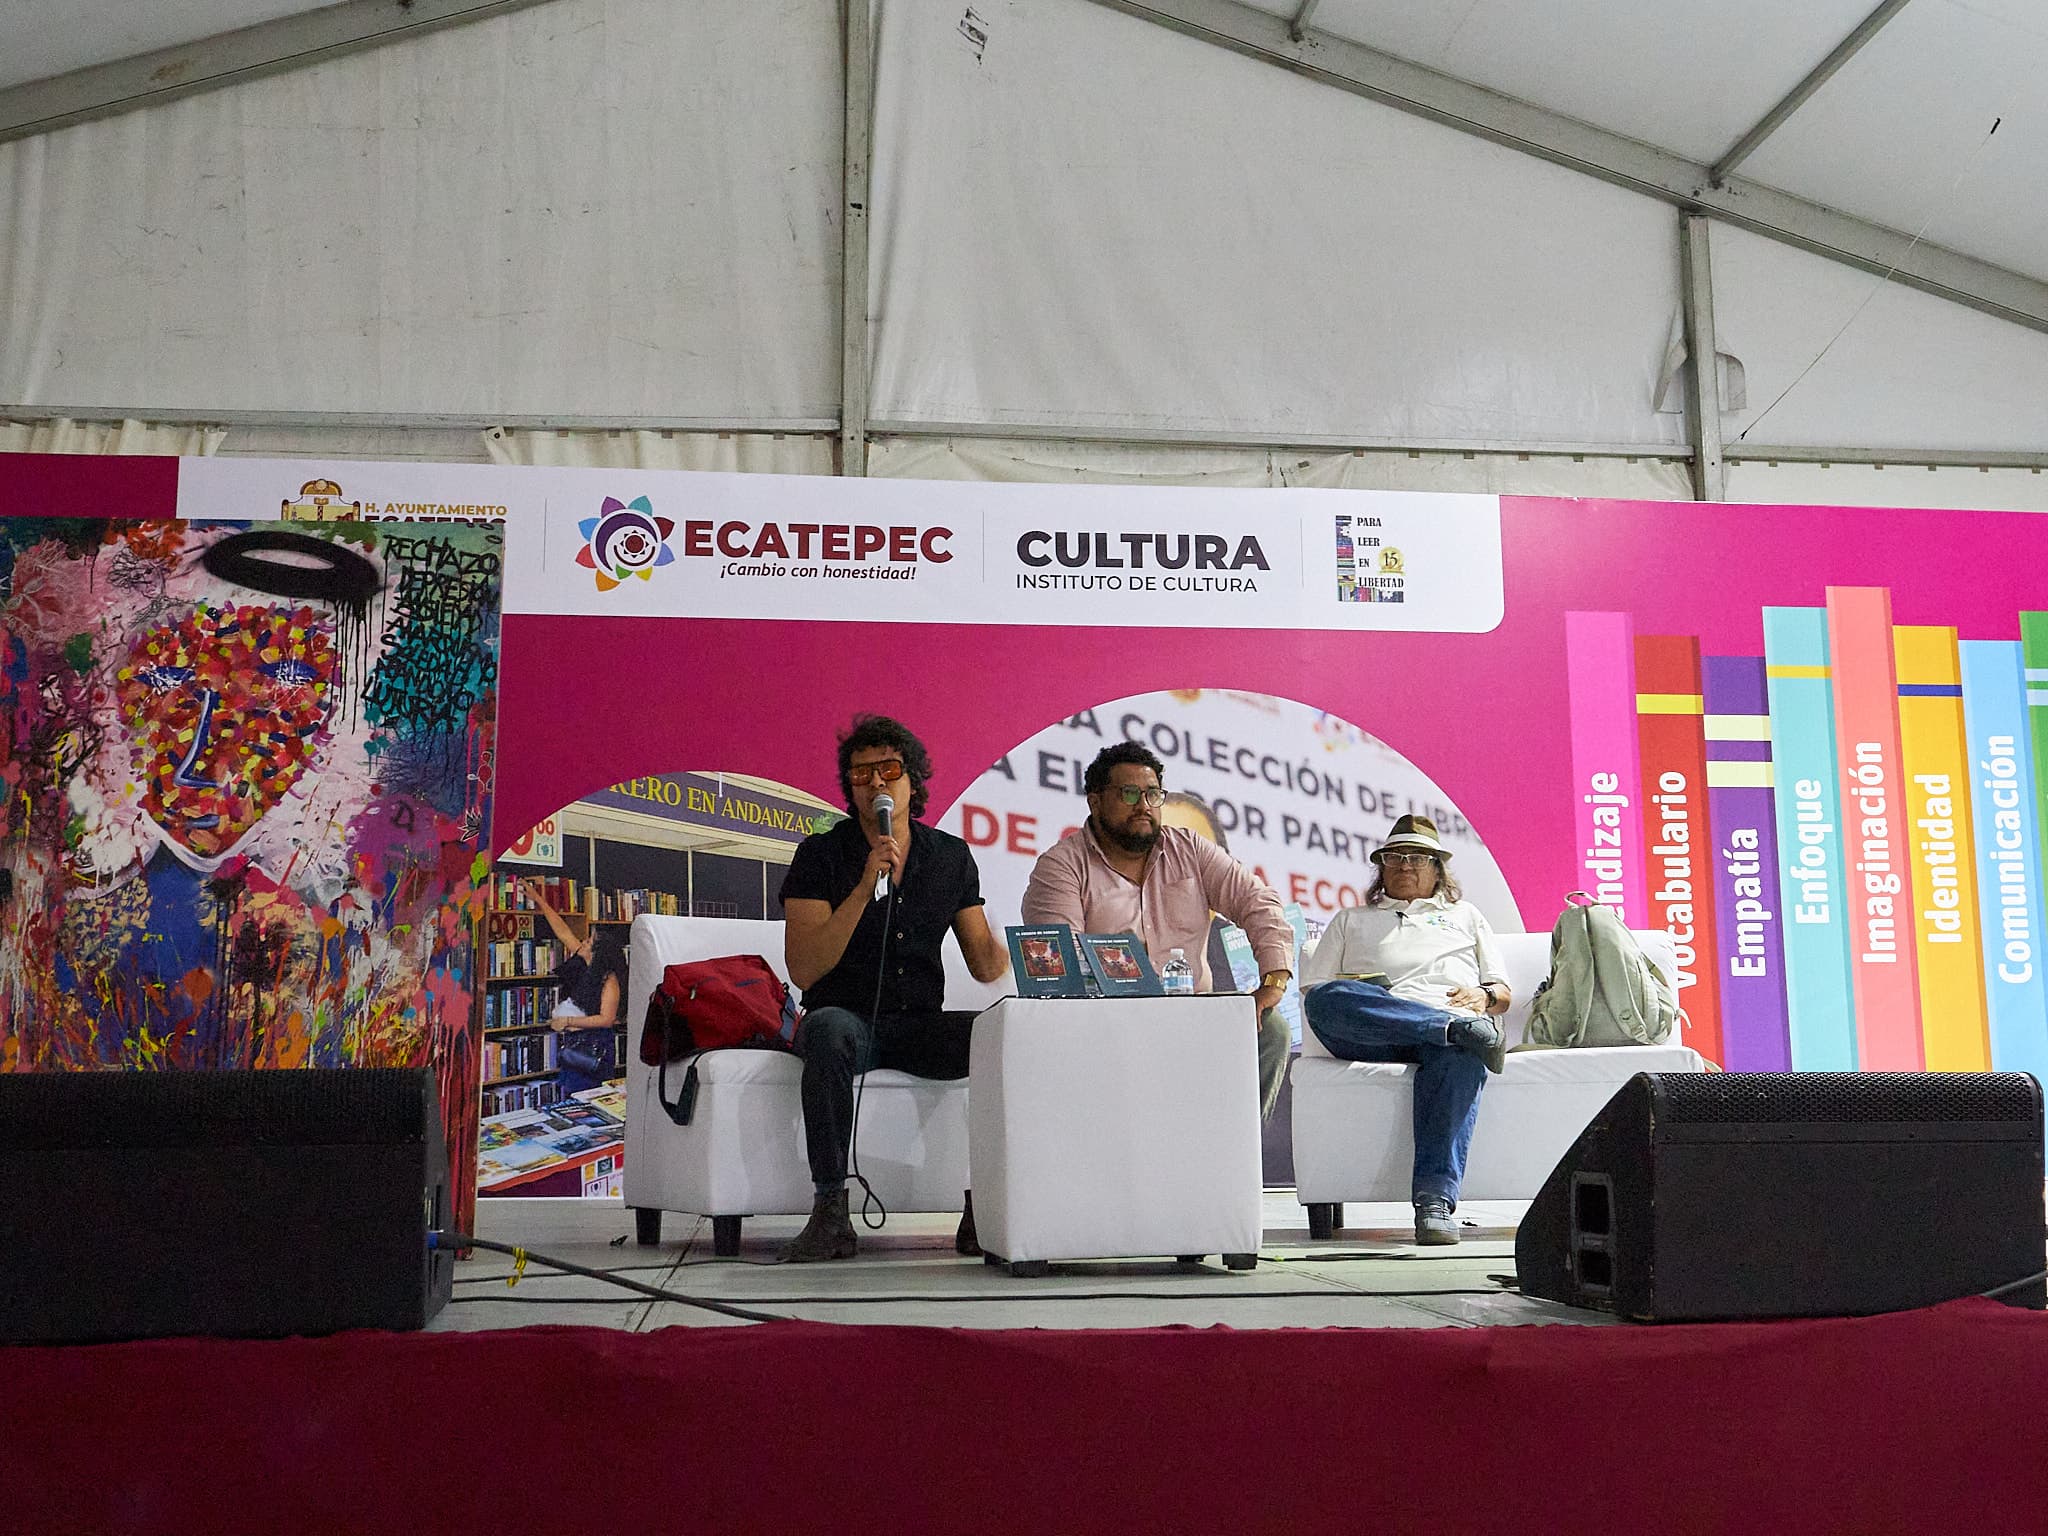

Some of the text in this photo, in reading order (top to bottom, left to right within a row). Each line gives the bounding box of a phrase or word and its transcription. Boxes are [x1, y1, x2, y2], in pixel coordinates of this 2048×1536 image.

[364, 502, 508, 516] H. AYUNTAMIENTO
[1356, 517, 1382, 527] PARA
[383, 534, 500, 575] RECHAZO
[684, 519, 955, 564] ECATEPEC
[1016, 530, 1271, 571] CULTURA
[1357, 536, 1380, 547] LEER
[1358, 558, 1370, 568] EN
[720, 562, 917, 581] ¡Cambio con honestidad!
[1016, 573, 1258, 593] INSTITUTO DE CULTURA
[1358, 576, 1404, 588] LIBERTAD
[1120, 714, 1346, 804] COLECCIÓN
[1358, 784, 1397, 820] DE
[687, 787, 716, 815] EN
[721, 797, 814, 836] ANDANZAS
[962, 803, 1038, 856] DE
[1184, 789, 1236, 839] OR
[1283, 815, 1387, 864] PART
[1585, 772, 1630, 923] ndizaje
[1790, 778, 1833, 924] Enfoque
[1847, 741, 1901, 963] Imaginación
[1913, 773, 1962, 943] Identidad
[1981, 735, 2033, 984] Comunicación
[1288, 872, 1366, 912] ECO
[1722, 828, 1772, 977] Empatía
